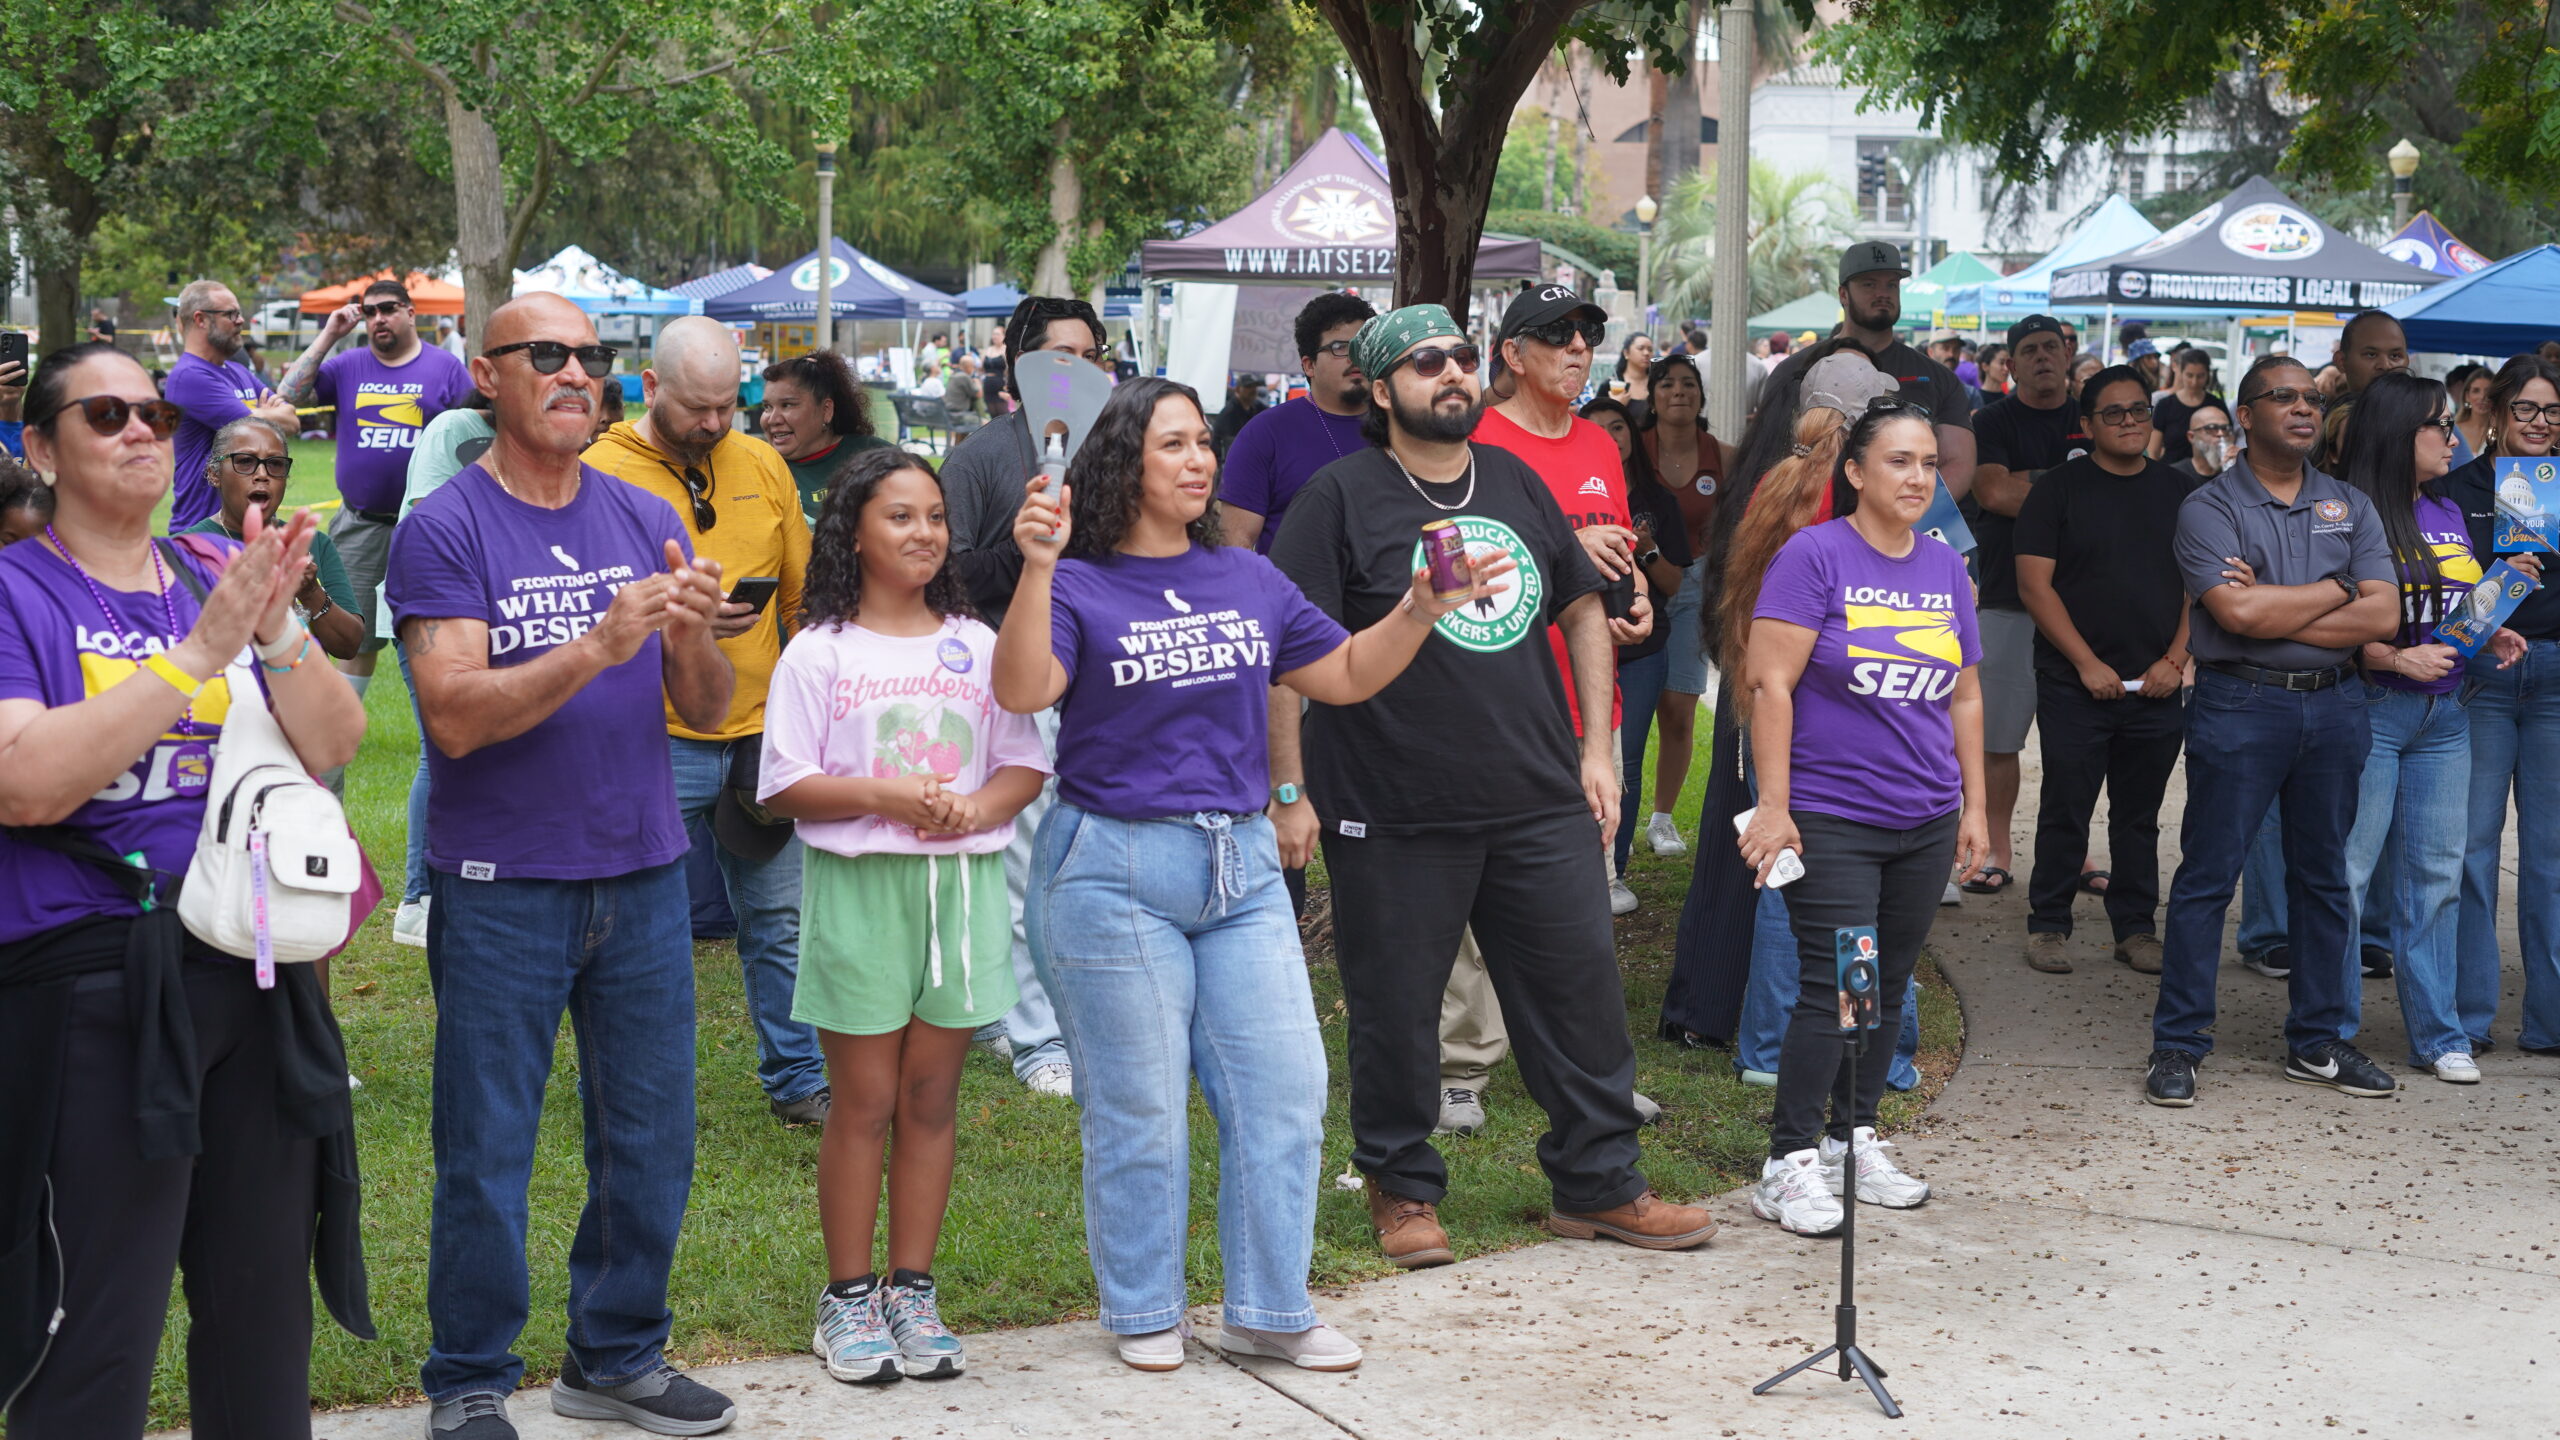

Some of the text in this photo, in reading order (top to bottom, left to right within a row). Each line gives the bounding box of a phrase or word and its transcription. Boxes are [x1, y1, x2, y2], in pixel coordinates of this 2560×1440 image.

[1871, 246, 1887, 263] LA
[1540, 286, 1576, 302] CFA
[2150, 273, 2291, 304] IRONWORKERS
[2295, 278, 2354, 306] LOCAL
[358, 382, 423, 394] LOCAL 721
[357, 427, 422, 448] SEIU
[2525, 519, 2545, 528] YOUR
[1458, 524, 1518, 553] BUCKS
[511, 571, 598, 592] FIGHTING
[598, 565, 634, 581] FOR
[496, 588, 596, 620] WHAT
[1505, 572, 1538, 632] UNITED
[1844, 586, 1953, 609] LOCAL 721
[1129, 609, 1241, 633] FIGHTING FOR
[1441, 610, 1491, 641] RKERS
[1117, 619, 1265, 656] WHAT WE
[1110, 640, 1271, 687] DESERVE
[1171, 671, 1237, 689] SEIU LOCAL 1000
[1847, 661, 1960, 701] SEIU
[833, 664, 994, 725] Strawberry
[177, 776, 208, 787] SEIU
[1344, 824, 1363, 832] UNION
[466, 864, 491, 873] UNION
